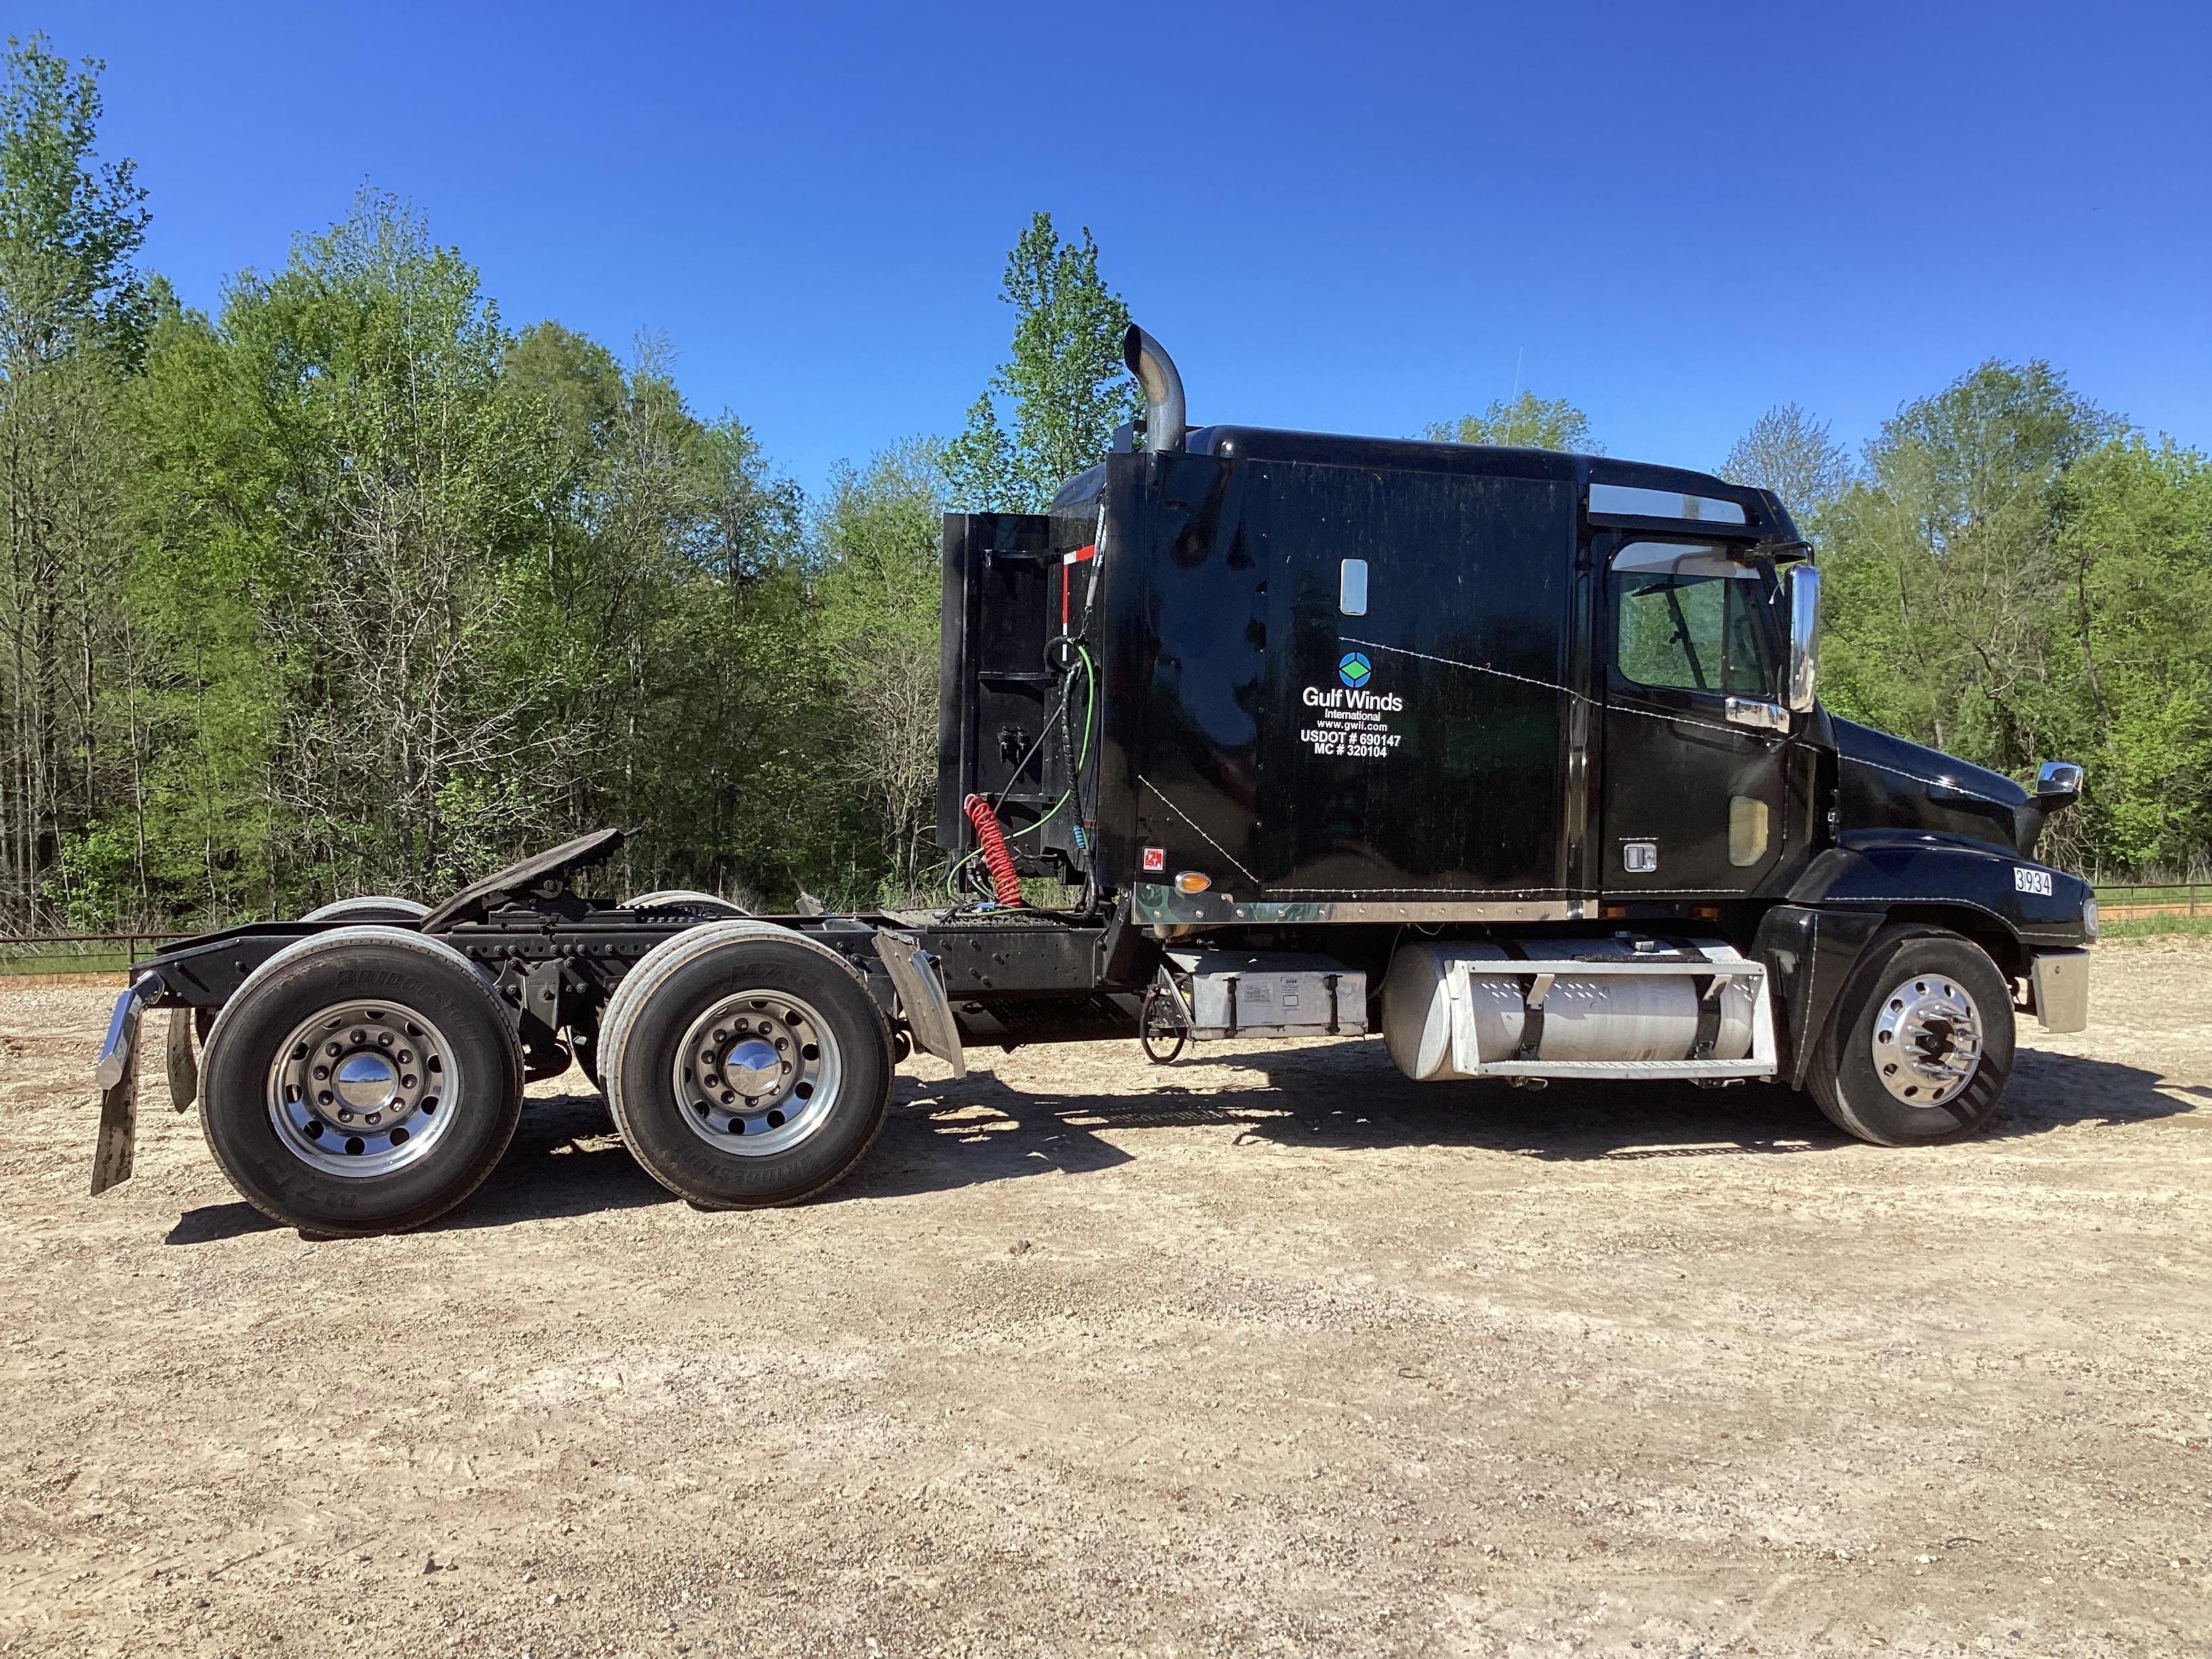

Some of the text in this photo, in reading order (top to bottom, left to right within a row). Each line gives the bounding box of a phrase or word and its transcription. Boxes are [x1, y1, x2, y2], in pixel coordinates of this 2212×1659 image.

[1303, 687, 1403, 712] Gulf Winds
[1324, 708, 1381, 722] International
[1317, 720, 1387, 732] www.gwii.com
[1300, 729, 1401, 747] USDOT # 690147
[1314, 743, 1387, 758] MC # 320104
[2016, 869, 2050, 894] 3934
